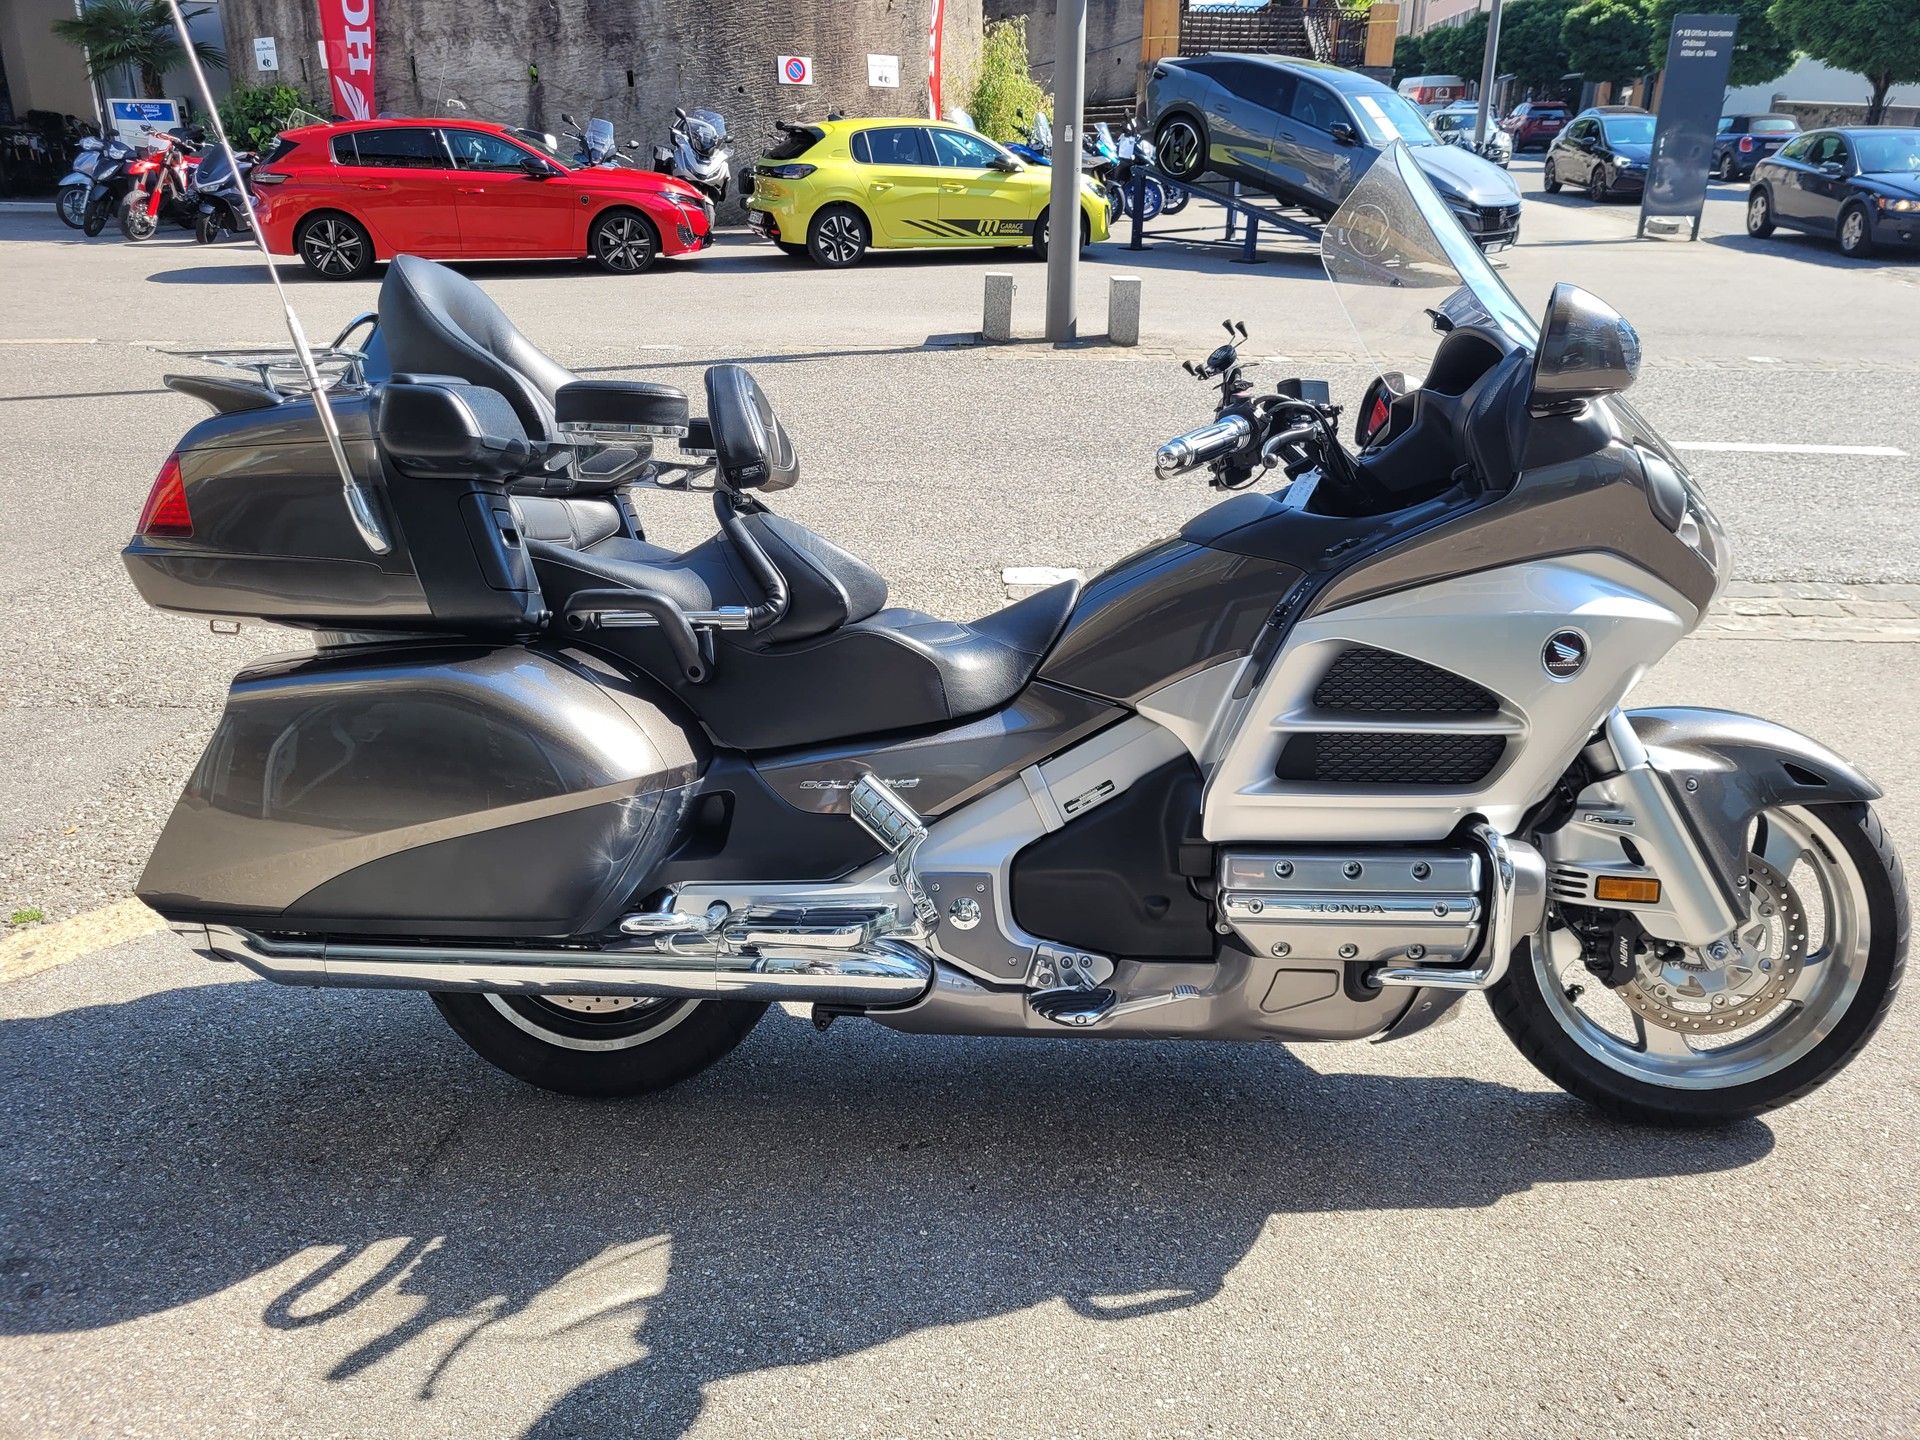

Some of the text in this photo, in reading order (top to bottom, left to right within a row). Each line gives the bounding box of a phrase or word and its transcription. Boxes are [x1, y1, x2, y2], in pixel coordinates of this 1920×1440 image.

[1691, 29, 1733, 37] Office tourisme
[1682, 39, 1706, 47] Château
[1680, 49, 1718, 57] Hôtel de Ville
[1310, 902, 1387, 914] HONDA
